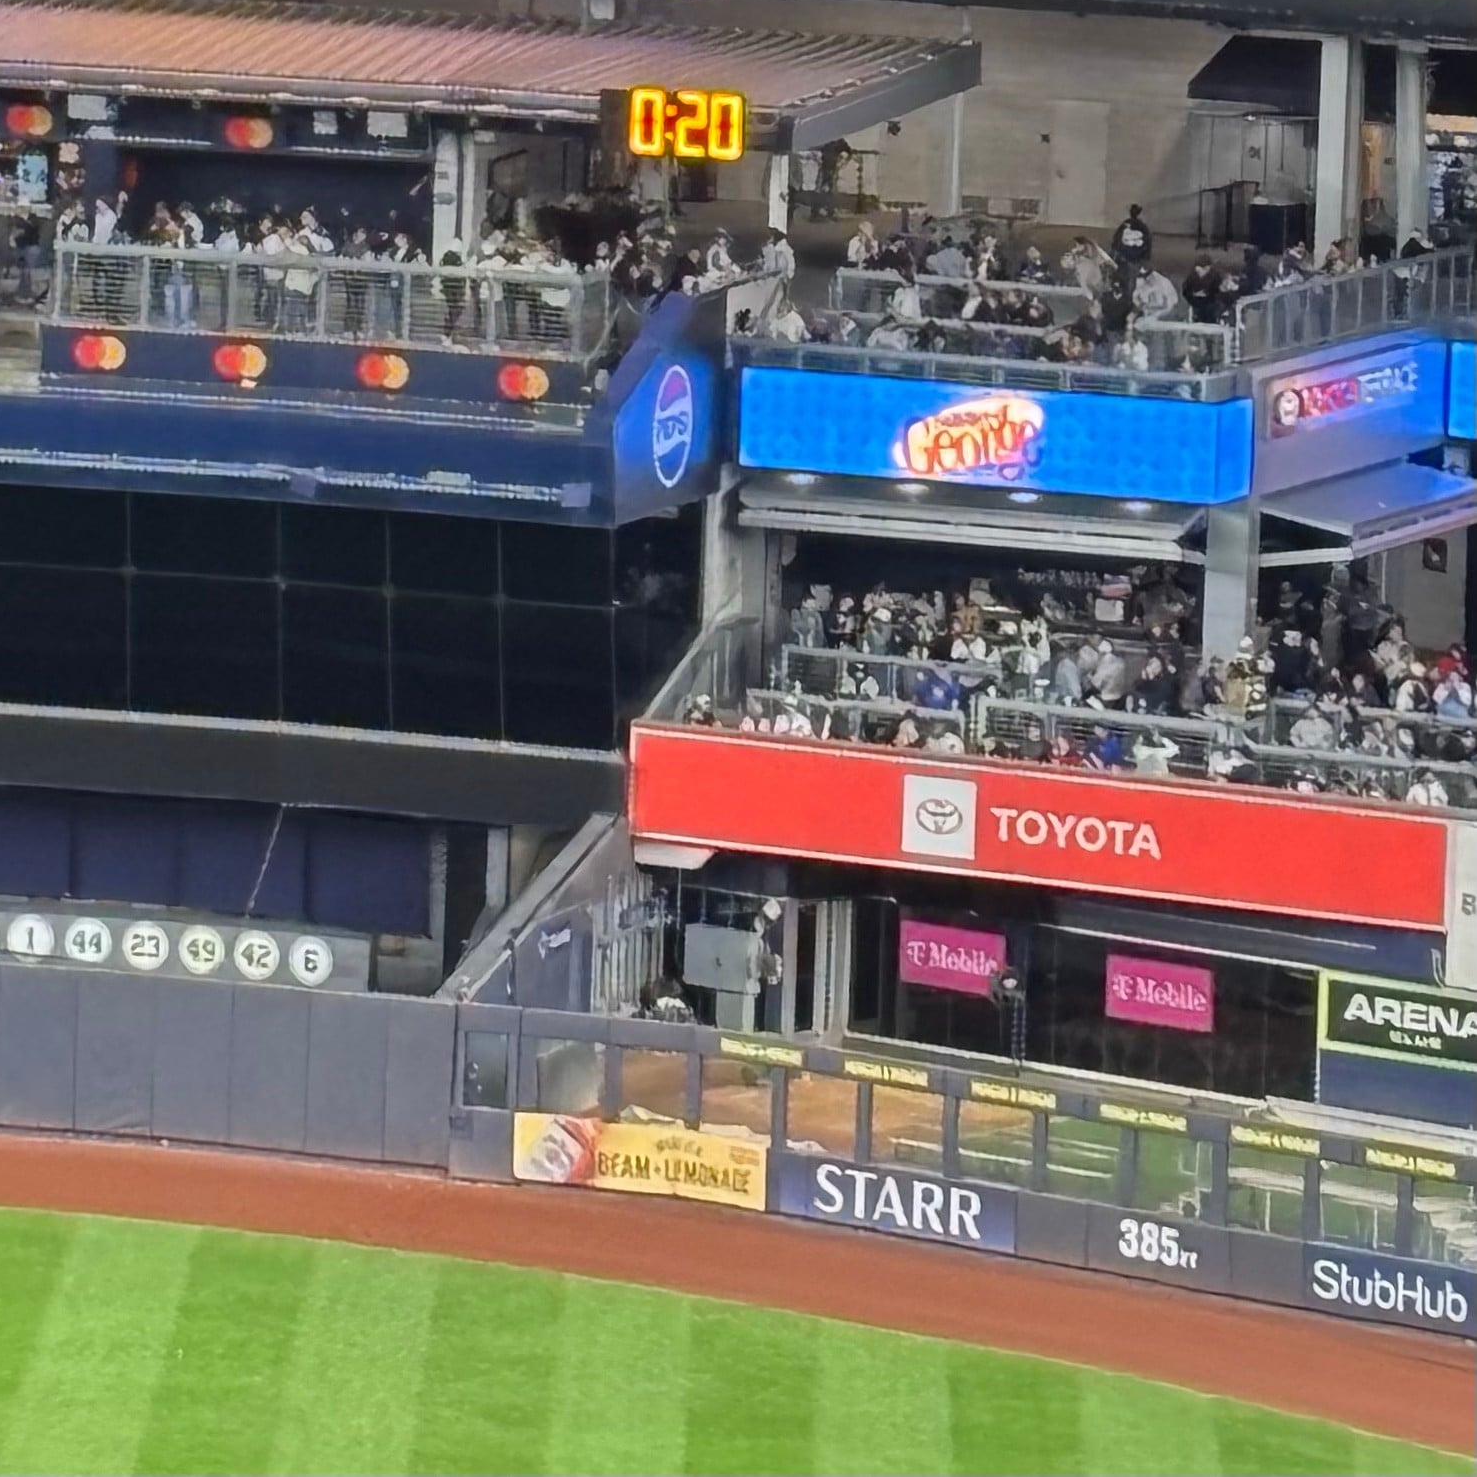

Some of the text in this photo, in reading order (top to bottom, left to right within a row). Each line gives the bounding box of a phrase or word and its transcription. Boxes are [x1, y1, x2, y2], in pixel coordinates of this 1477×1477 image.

[629, 86, 744, 161] 0:20
[990, 807, 1161, 860] TOYOTA
[26, 927, 34, 951] 1
[131, 933, 160, 958] 23
[240, 943, 272, 969] 42
[598, 1151, 651, 1180] BEAM
[814, 1163, 982, 1240] STARR
[1312, 1259, 1469, 1322] StubHub
